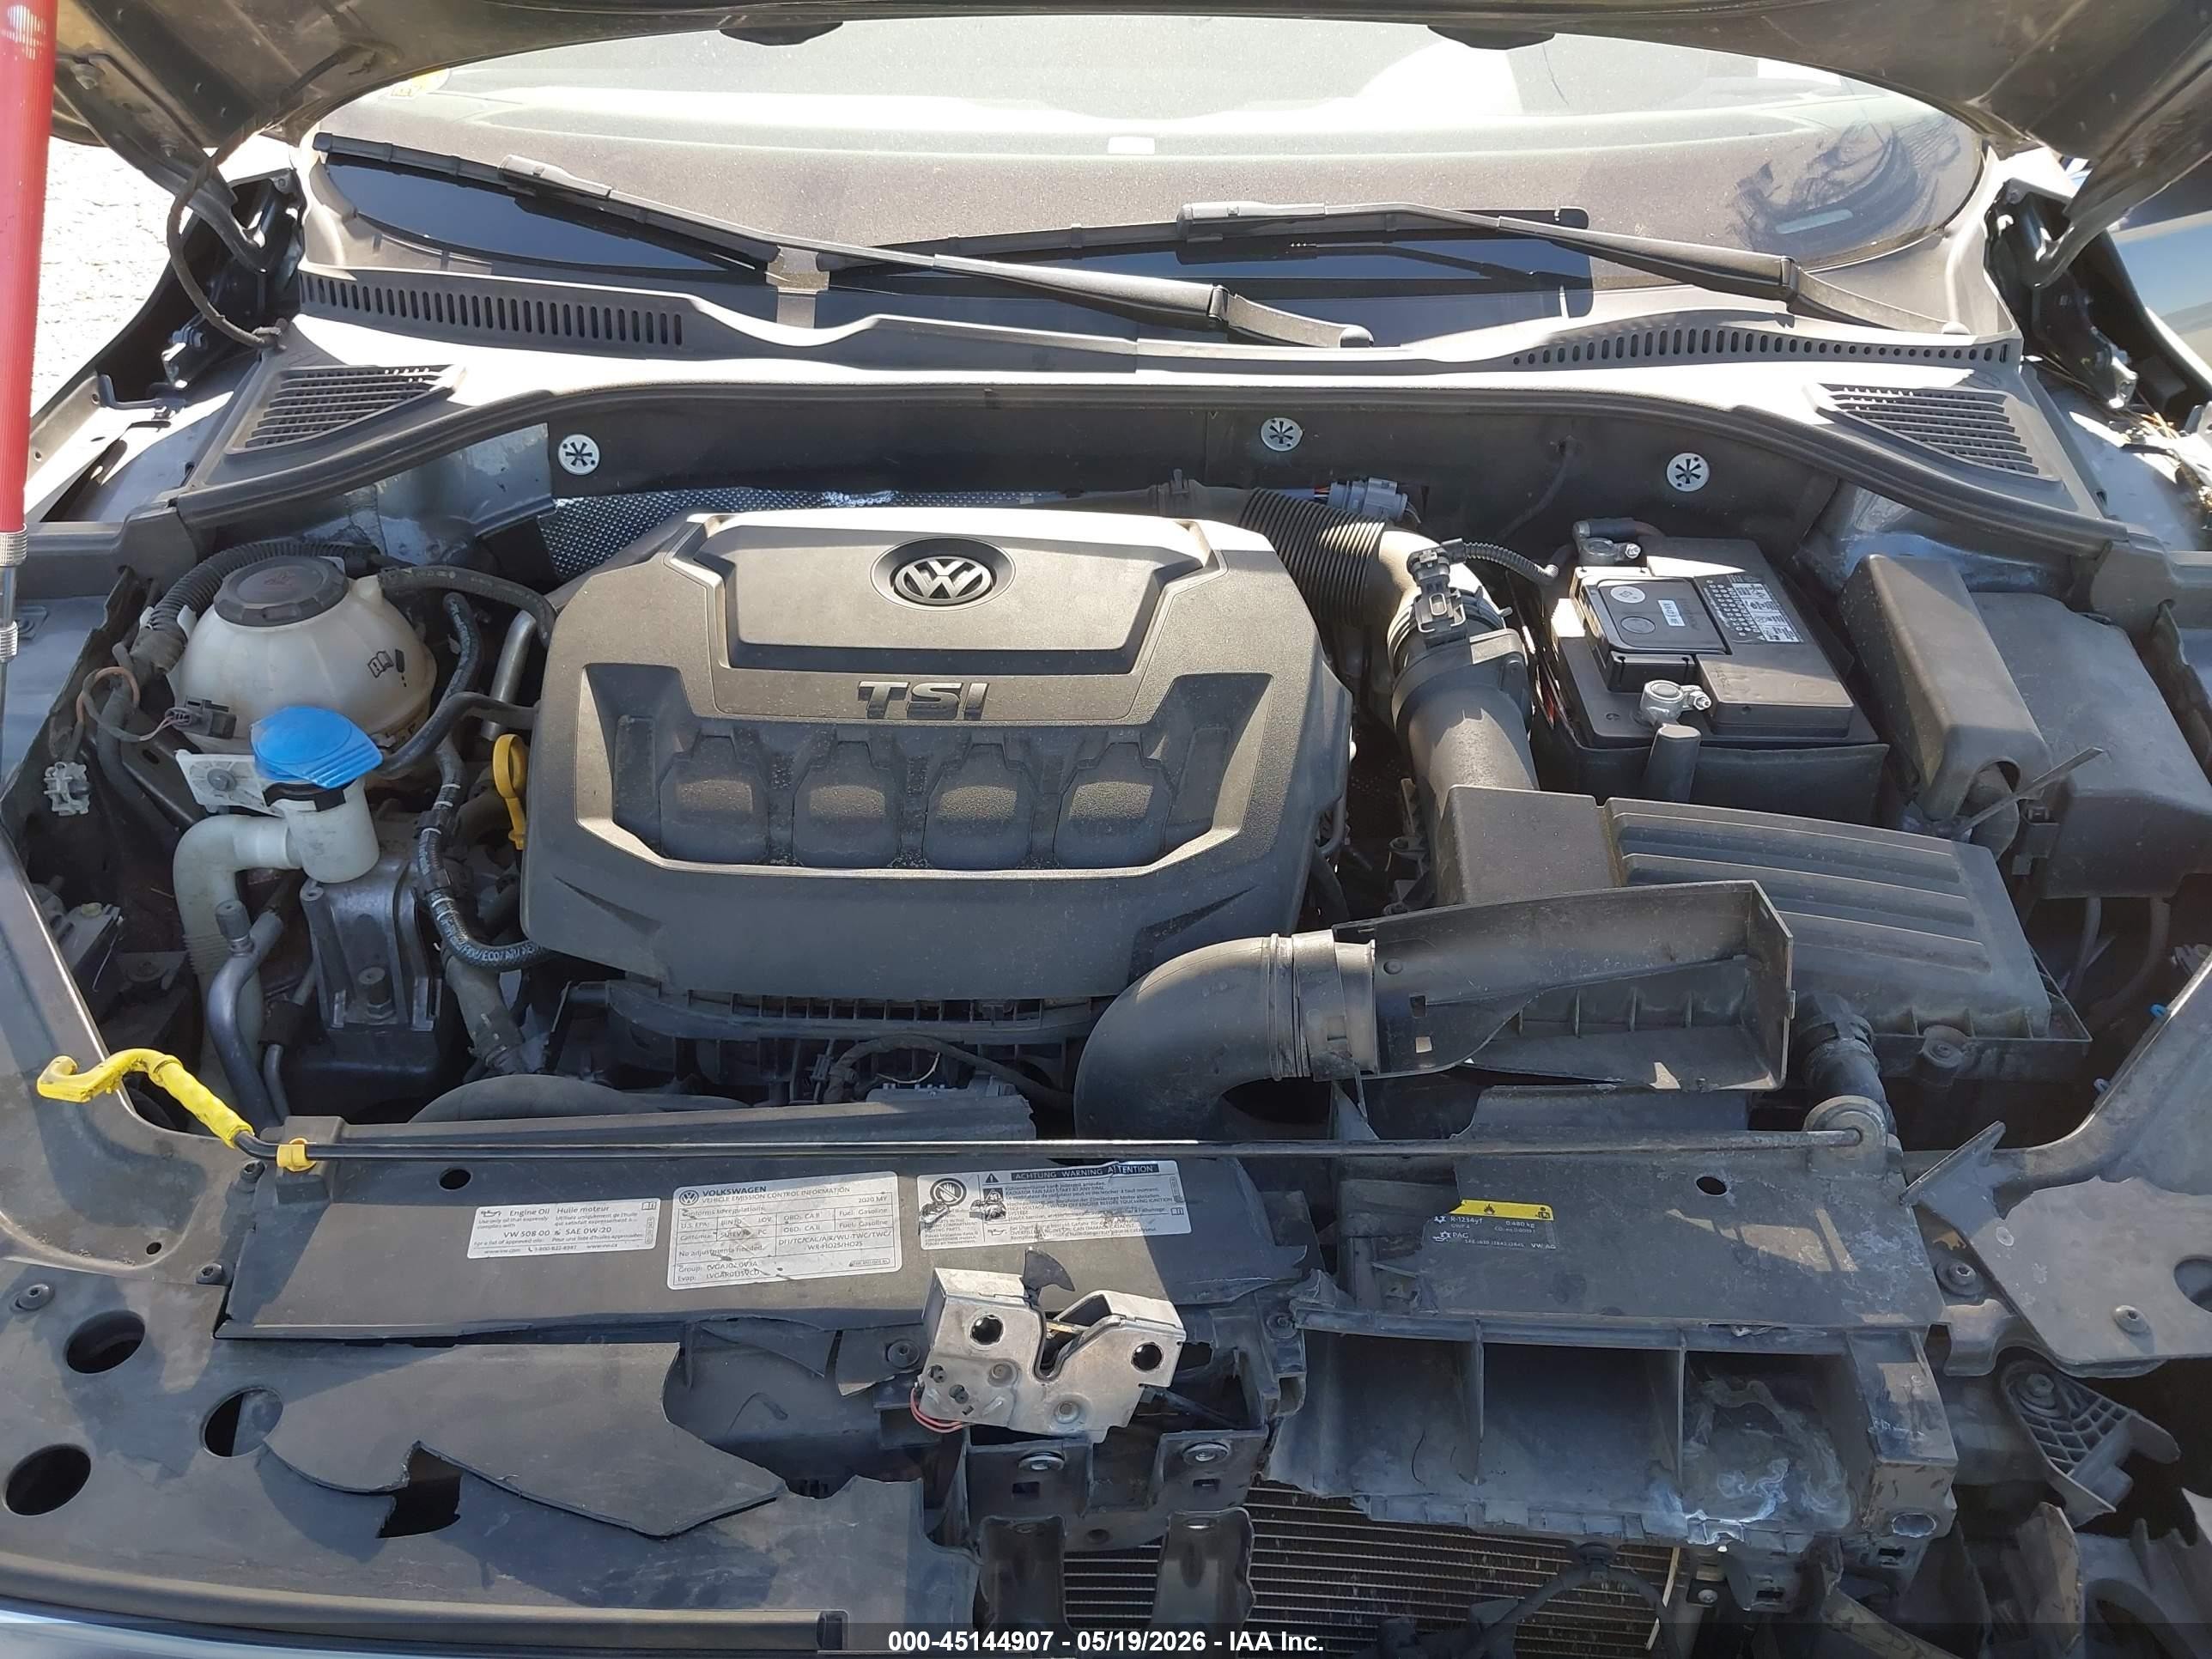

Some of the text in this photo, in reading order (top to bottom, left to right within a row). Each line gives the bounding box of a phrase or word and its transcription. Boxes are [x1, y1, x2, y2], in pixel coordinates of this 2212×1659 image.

[858, 681, 990, 720] TSI
[1015, 1164, 1153, 1180] ACHTUNG WARNING ATTENTION
[702, 1185, 767, 1197] VOLKSWAGEN
[732, 1193, 766, 1201] EMISSION
[767, 1190, 799, 1199] CONTROL
[800, 1187, 850, 1196] INFORMATION
[509, 1208, 537, 1218] Engine
[1450, 1215, 1483, 1225] R-1234yf
[583, 1225, 612, 1235] 0W-20
